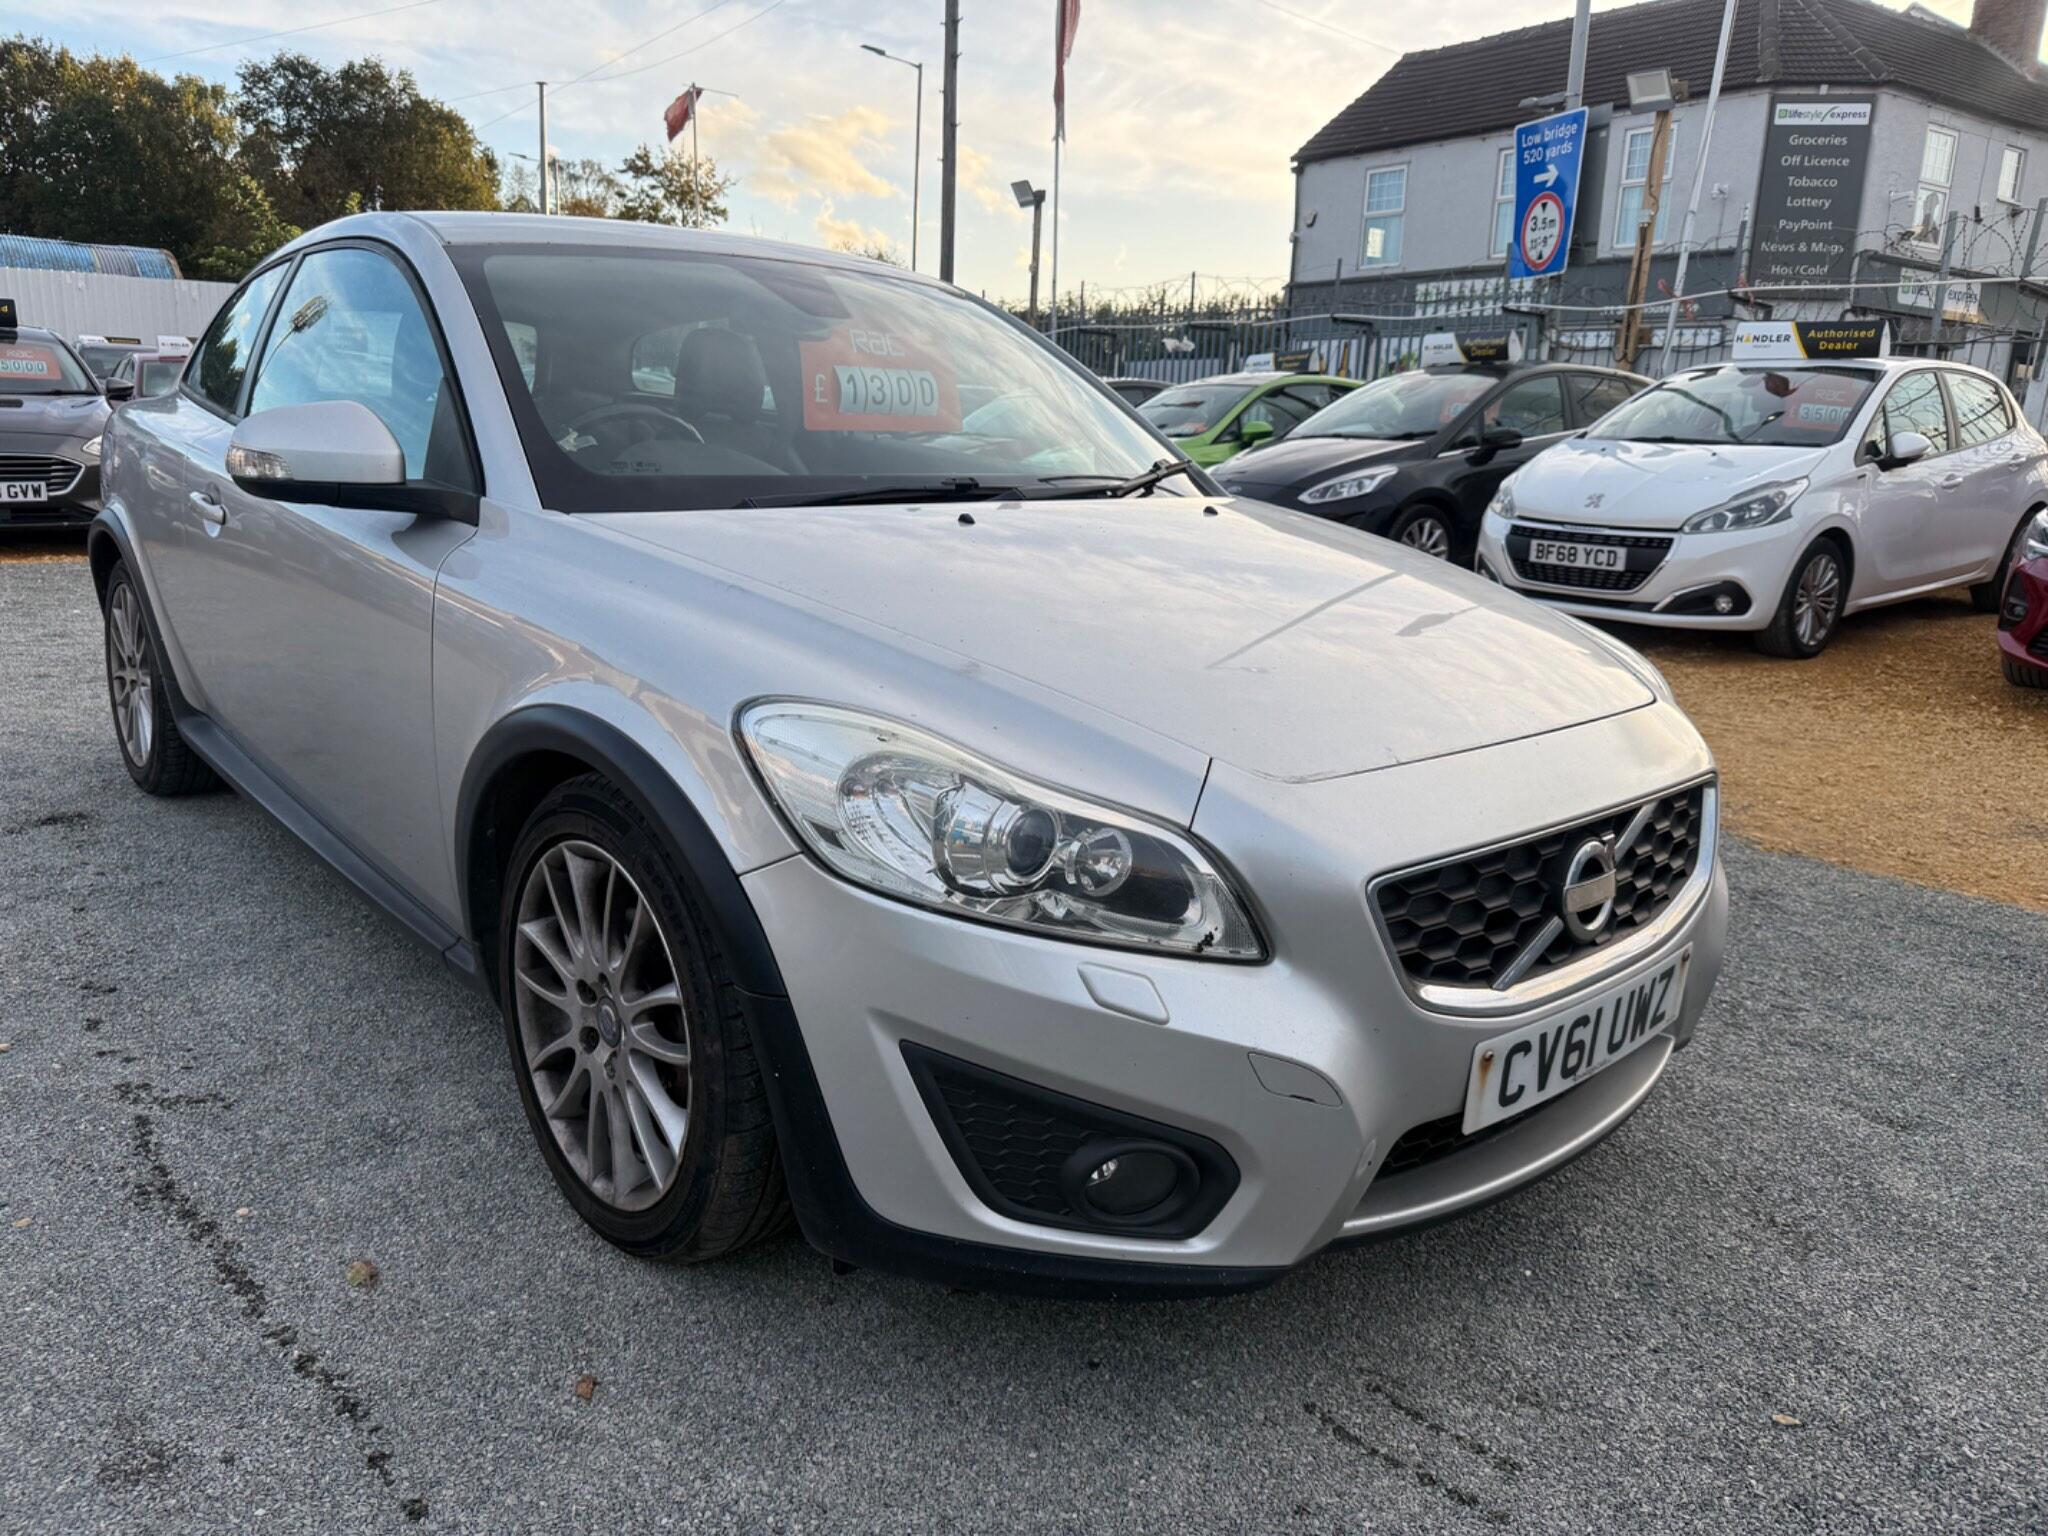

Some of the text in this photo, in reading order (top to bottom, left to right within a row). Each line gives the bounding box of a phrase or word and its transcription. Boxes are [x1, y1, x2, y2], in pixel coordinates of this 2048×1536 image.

[1830, 111, 1867, 121] express
[1522, 123, 1578, 148] Low bridge
[1789, 134, 1848, 146] Groceries
[1523, 141, 1573, 165] 520 yards
[1781, 155, 1850, 167] Off Licence
[1787, 176, 1838, 188] Tobacco
[1786, 196, 1832, 210] Lottery
[1779, 219, 1833, 231] PayPoint
[1761, 241, 1796, 252] News
[1798, 242, 1807, 252] &
[1807, 328, 1876, 338] Authorised
[1819, 340, 1859, 350] Dealer
[846, 374, 934, 407] 1300
[7, 484, 42, 499] GVW
[1535, 543, 1617, 567] BF68 YCD
[1498, 964, 1676, 1108] CV61 UWZ
